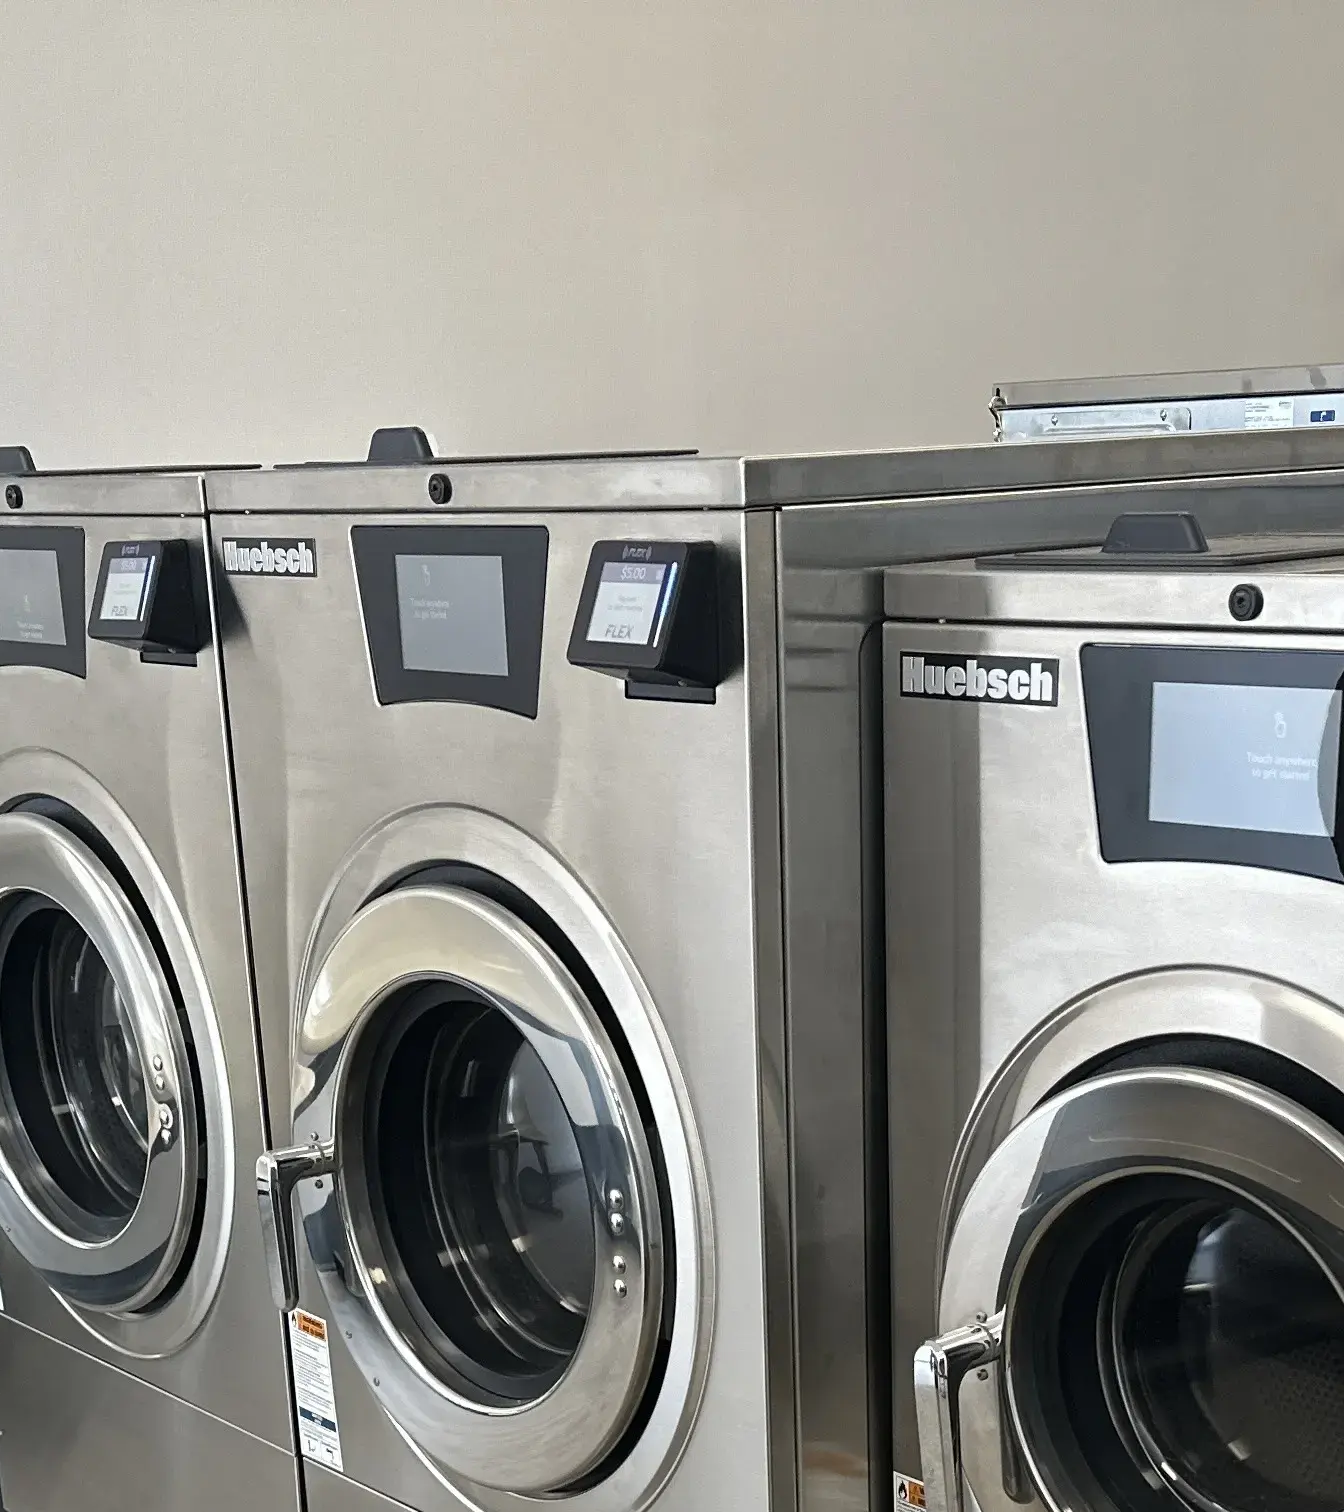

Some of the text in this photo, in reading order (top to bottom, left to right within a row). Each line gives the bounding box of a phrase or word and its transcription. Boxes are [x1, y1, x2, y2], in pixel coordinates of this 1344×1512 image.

[222, 541, 314, 574] Huebsch
[620, 565, 647, 580] $5.00
[604, 624, 635, 640] FLEX
[902, 656, 1053, 702] Huebsch
